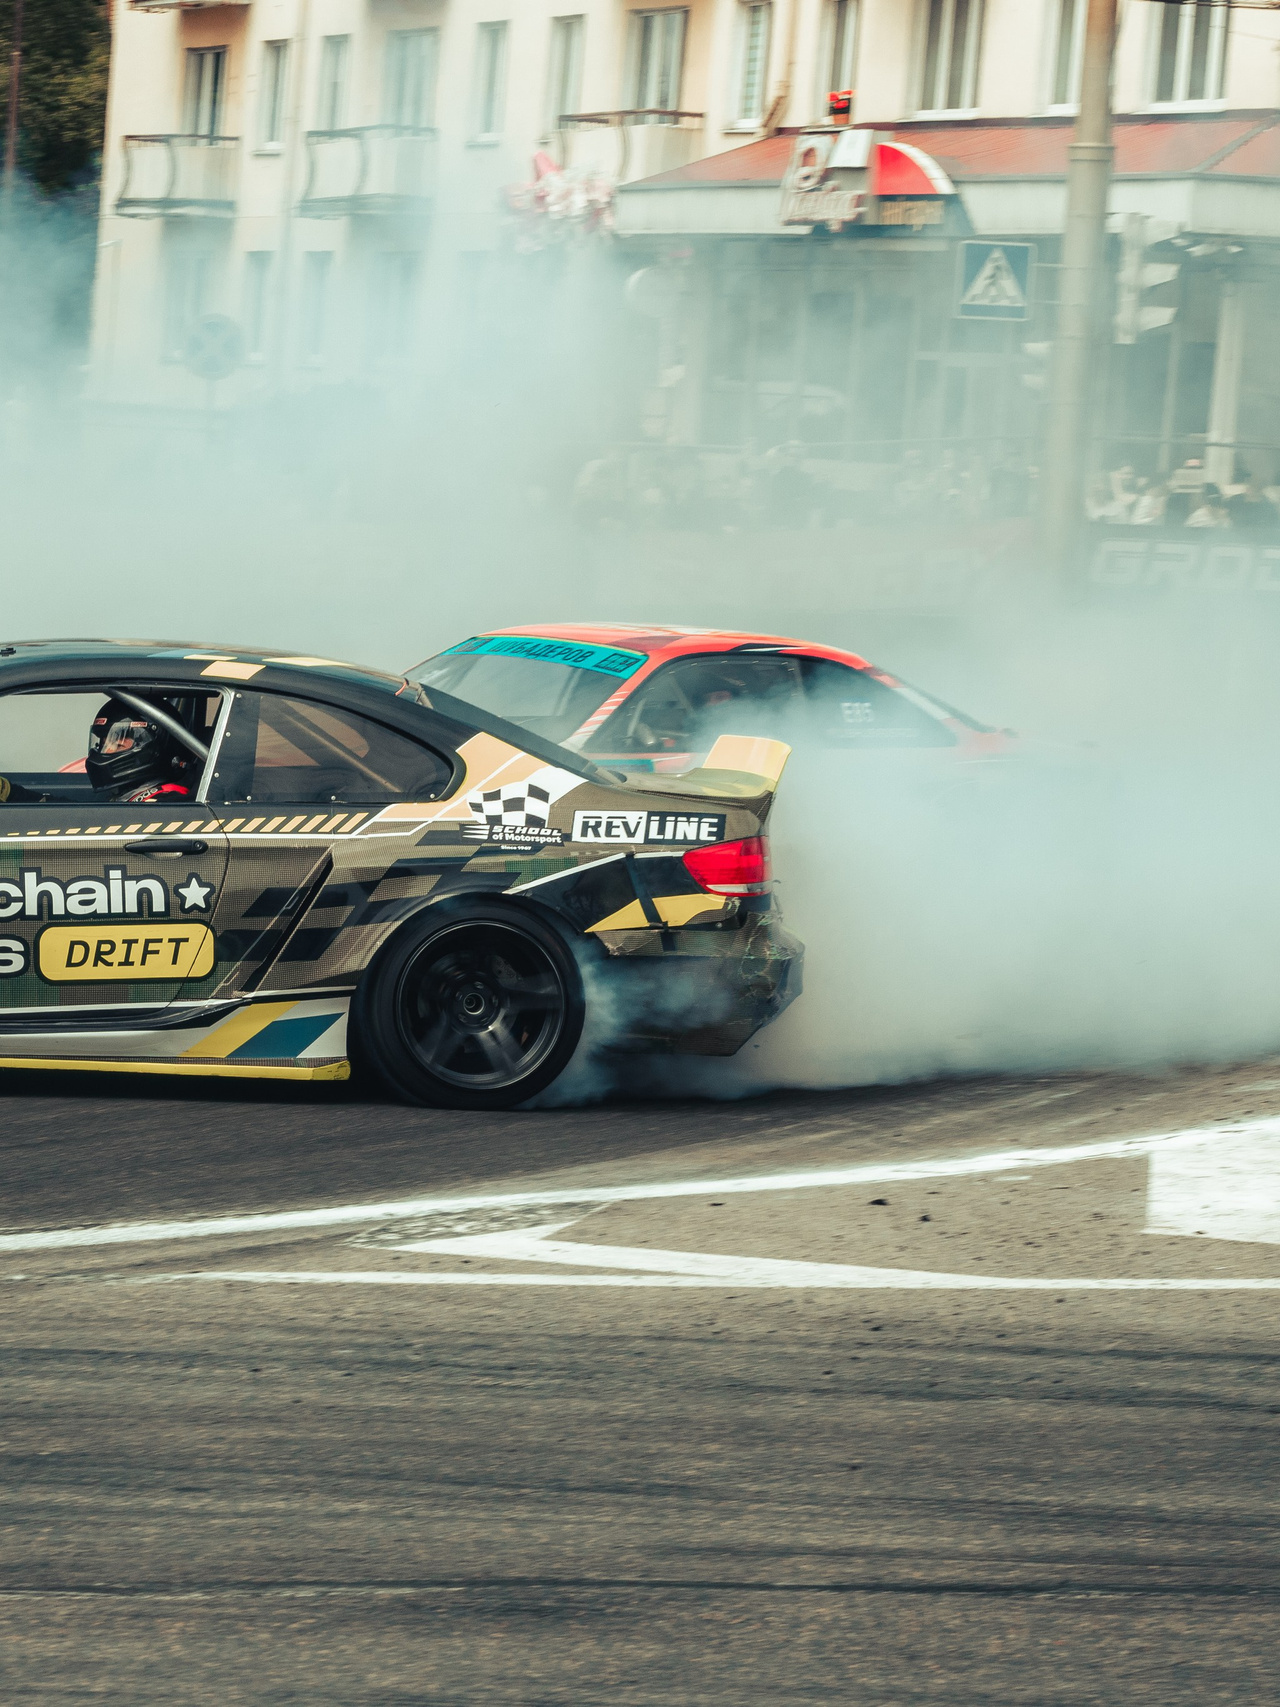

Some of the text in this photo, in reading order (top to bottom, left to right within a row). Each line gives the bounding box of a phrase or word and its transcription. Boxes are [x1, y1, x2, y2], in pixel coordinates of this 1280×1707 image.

[491, 825, 562, 836] SCHOOL
[492, 833, 563, 844] of Motorsport
[65, 937, 190, 968] DRIFT
